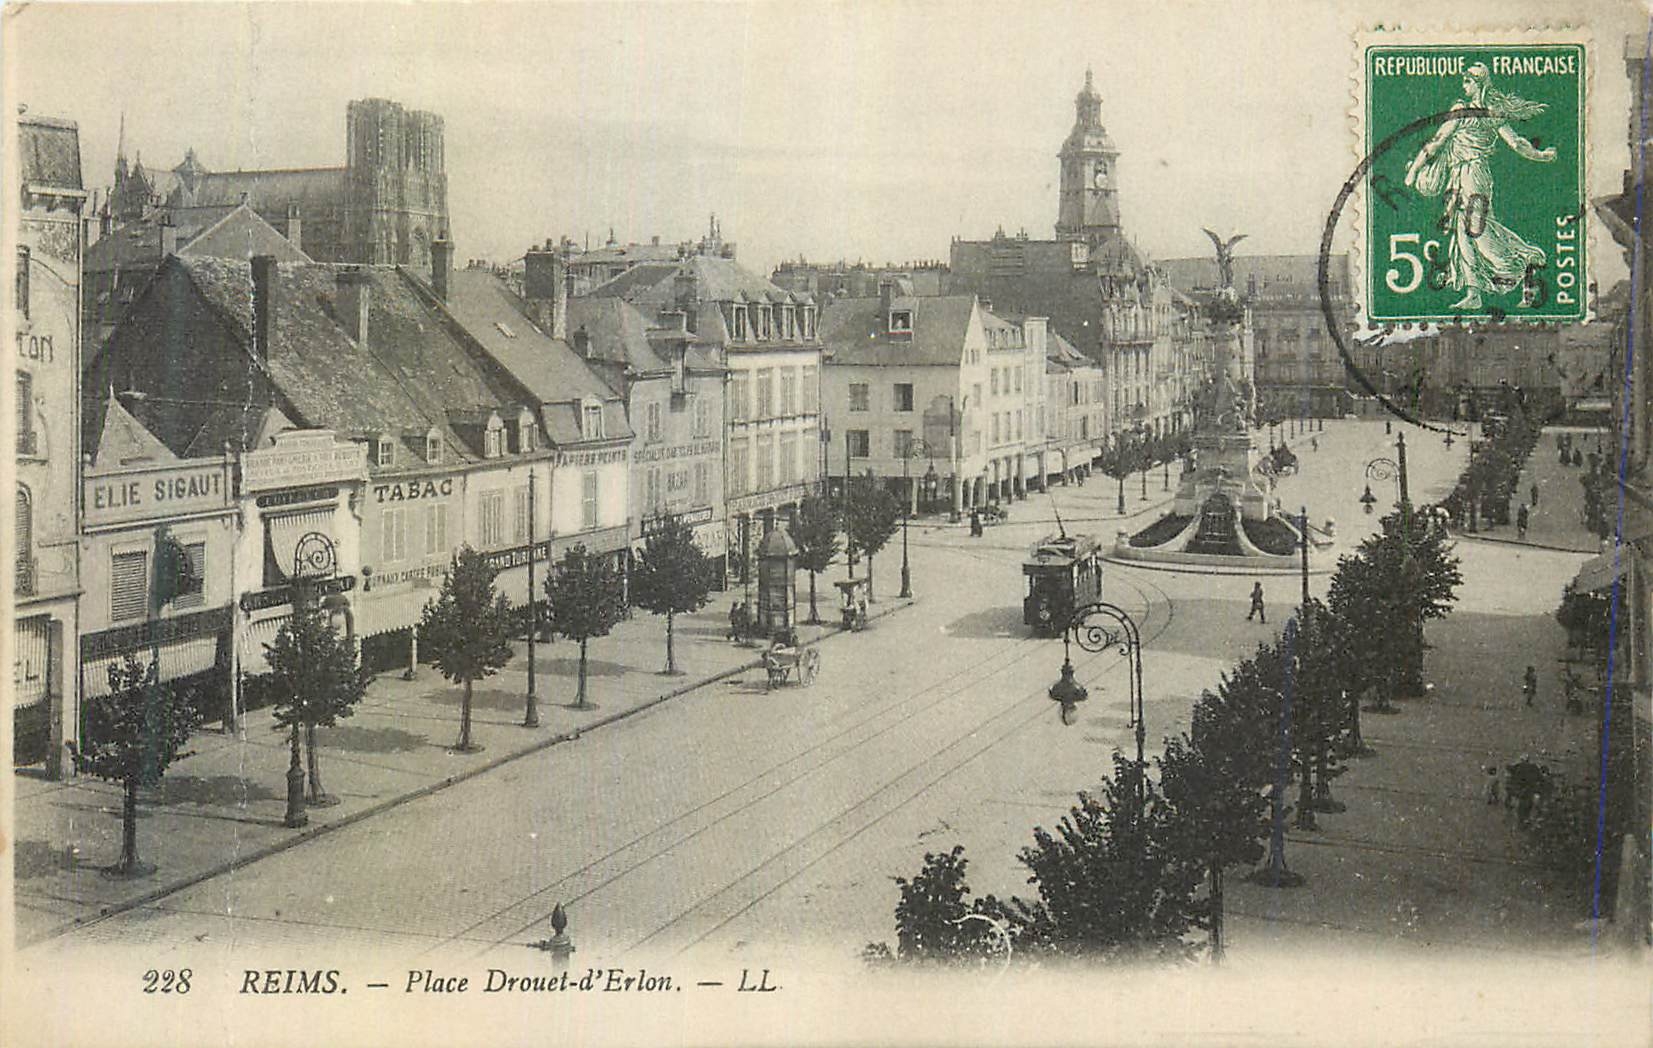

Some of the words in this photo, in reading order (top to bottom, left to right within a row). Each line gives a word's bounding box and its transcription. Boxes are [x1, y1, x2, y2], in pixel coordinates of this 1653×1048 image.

[1493, 55, 1576, 76] FRANÇAISE
[1556, 215, 1576, 305] POSTES
[95, 482, 141, 509] ELIE
[154, 473, 221, 501] SIGAUT
[374, 479, 453, 503] TABAC
